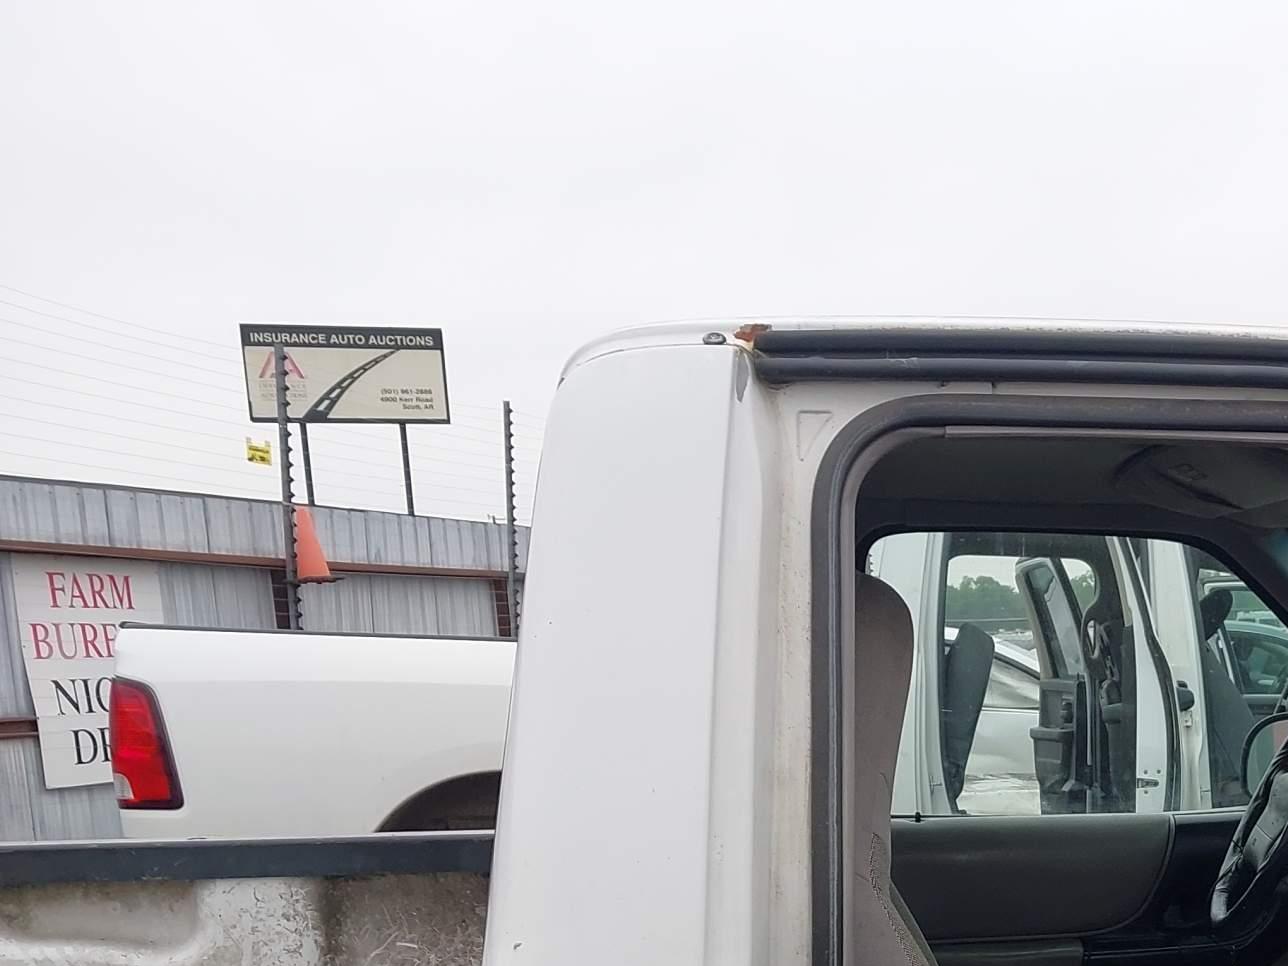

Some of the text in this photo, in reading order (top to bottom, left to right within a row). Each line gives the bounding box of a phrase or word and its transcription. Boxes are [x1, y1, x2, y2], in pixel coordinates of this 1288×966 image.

[249, 332, 434, 346] INSURANCE AUTO AUCTIONS
[45, 570, 136, 610] FARM
